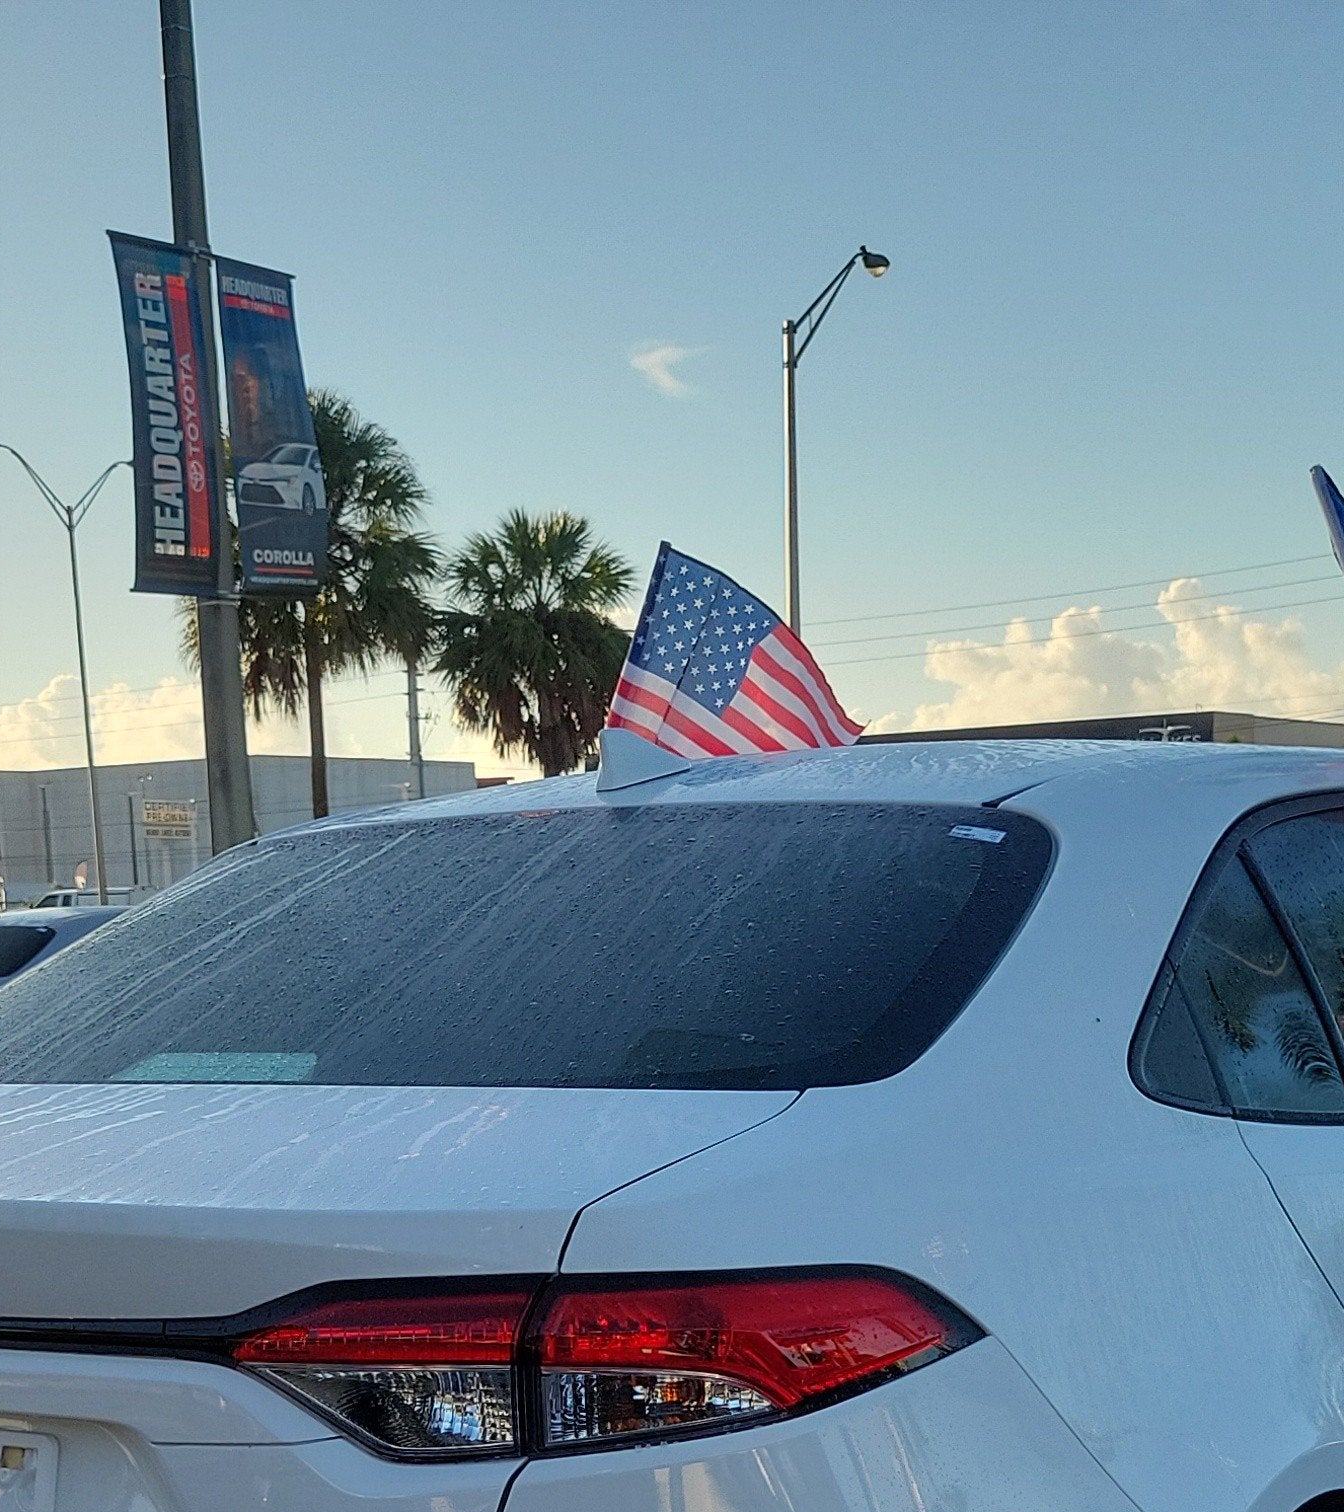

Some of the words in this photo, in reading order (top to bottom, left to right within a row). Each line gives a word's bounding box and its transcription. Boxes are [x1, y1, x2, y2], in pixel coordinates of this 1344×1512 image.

[221, 275, 288, 307] HEADQUARTER
[134, 272, 186, 556] HEADQUARTER
[179, 353, 201, 455] TOYOTA
[253, 549, 315, 567] COROLLA
